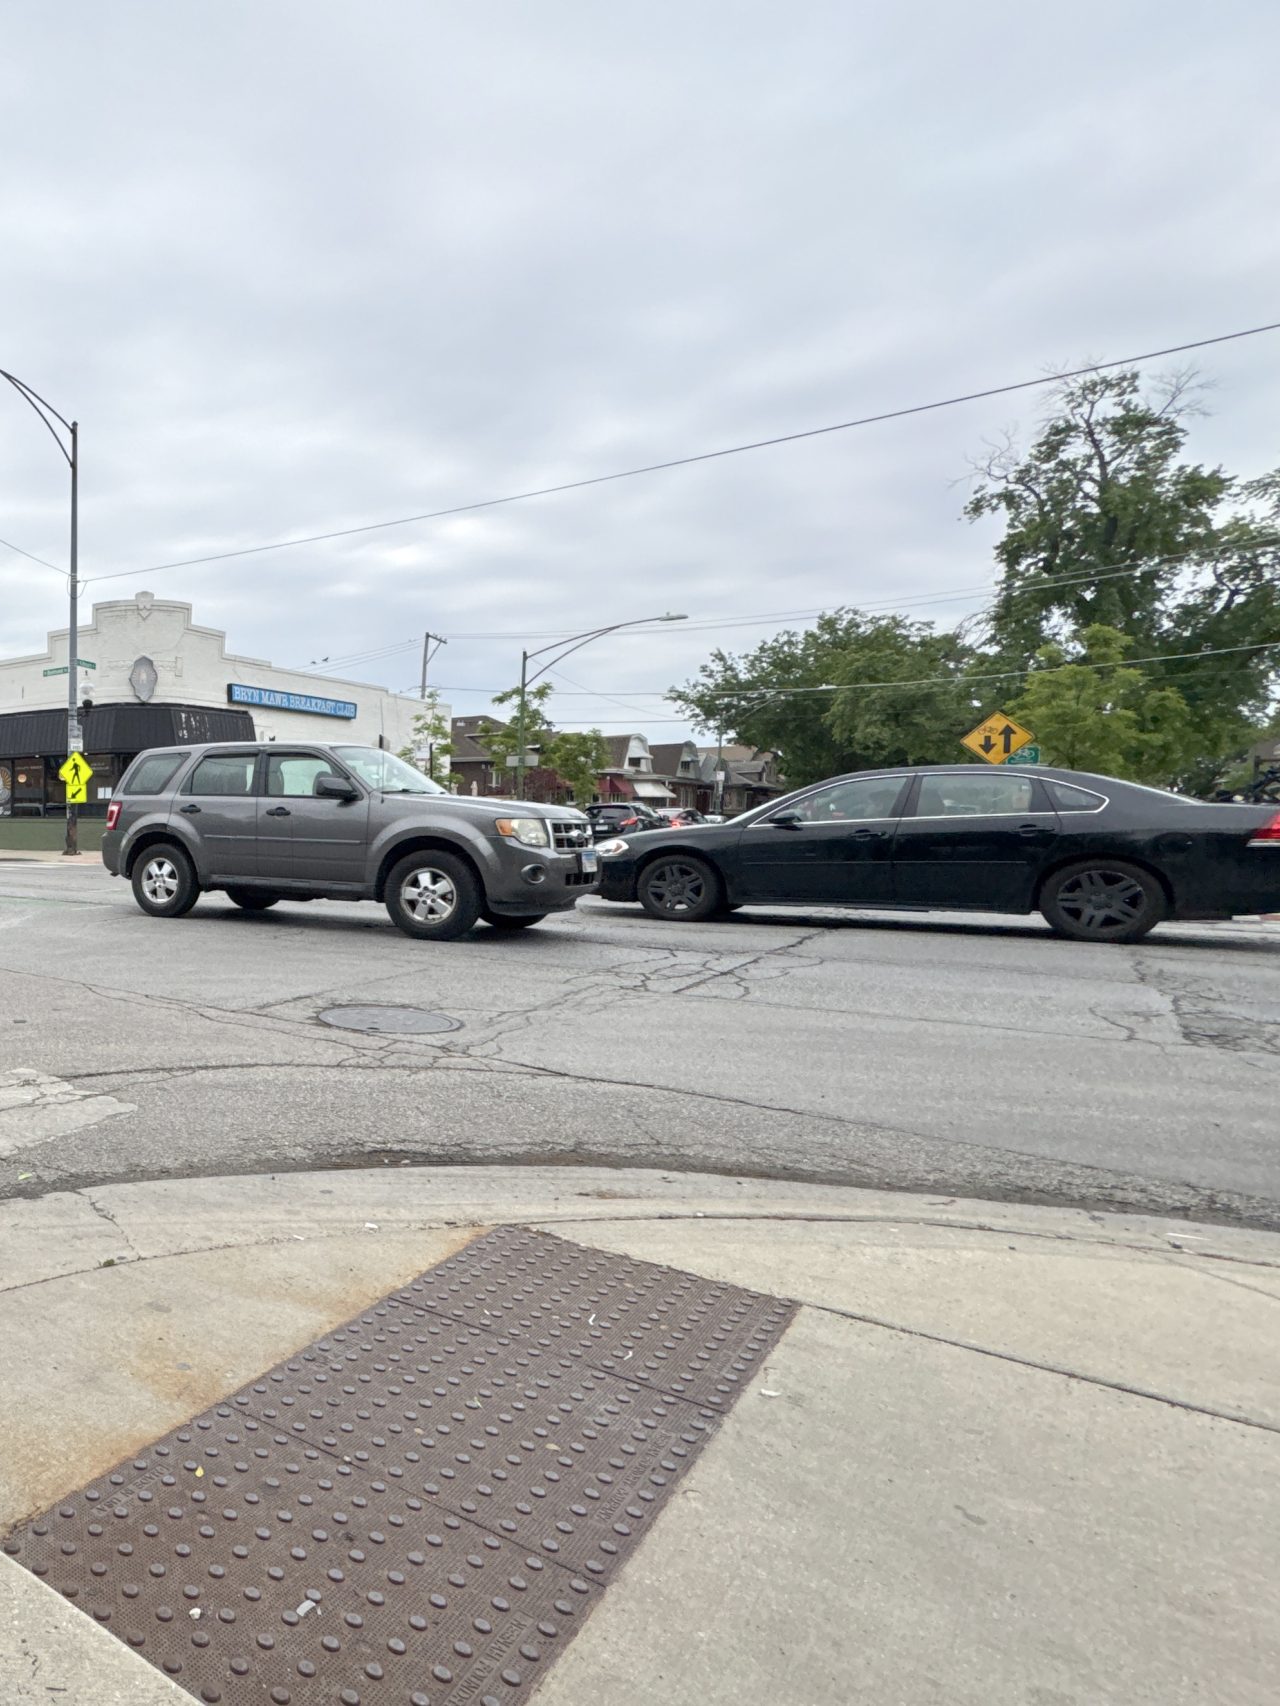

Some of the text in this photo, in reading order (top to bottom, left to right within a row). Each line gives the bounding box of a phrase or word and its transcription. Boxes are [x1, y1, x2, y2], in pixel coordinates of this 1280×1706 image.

[233, 687, 356, 717] BRYN MAWR BREAKFAST CLUB
